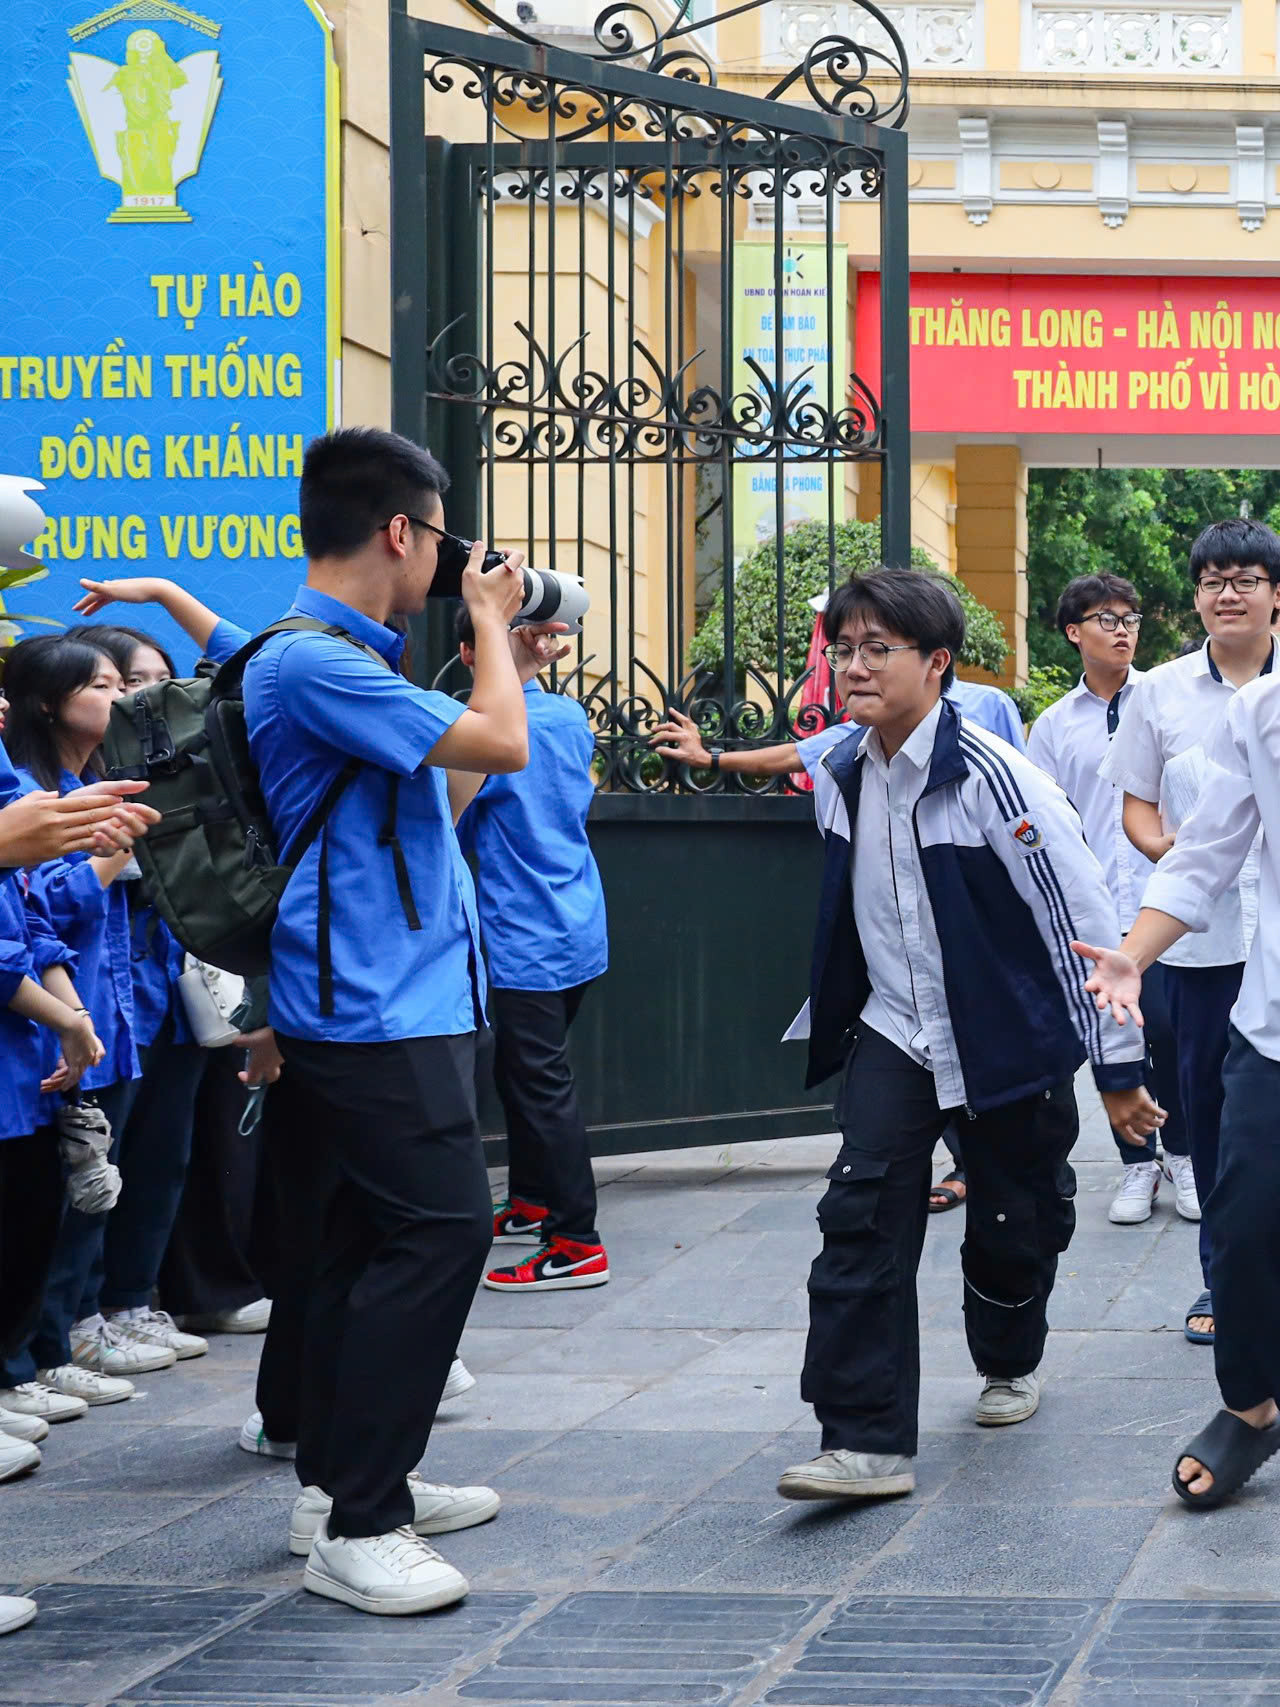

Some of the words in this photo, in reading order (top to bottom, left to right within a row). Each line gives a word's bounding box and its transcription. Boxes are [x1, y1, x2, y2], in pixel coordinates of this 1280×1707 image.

[133, 195, 166, 207] 1917
[150, 273, 206, 330] TỰ
[219, 261, 301, 318] HÀO
[744, 288, 766, 297] UBND
[909, 298, 1011, 346] THĂNG
[1021, 308, 1104, 348] LONG
[1113, 328, 1128, 338] -
[1137, 300, 1181, 349] HÀ
[1190, 301, 1242, 359] NỘI
[0, 337, 152, 400] TRUYỀN
[165, 336, 302, 399] THỐNG
[1013, 360, 1118, 409] THÀNH
[1129, 357, 1194, 411] PHỐ
[1199, 362, 1230, 411] VÌ
[40, 418, 151, 480] ĐỒNG
[165, 423, 302, 479] KHÁNH
[19, 514, 148, 560] RƯNG
[160, 514, 304, 560] VƯƠNG
